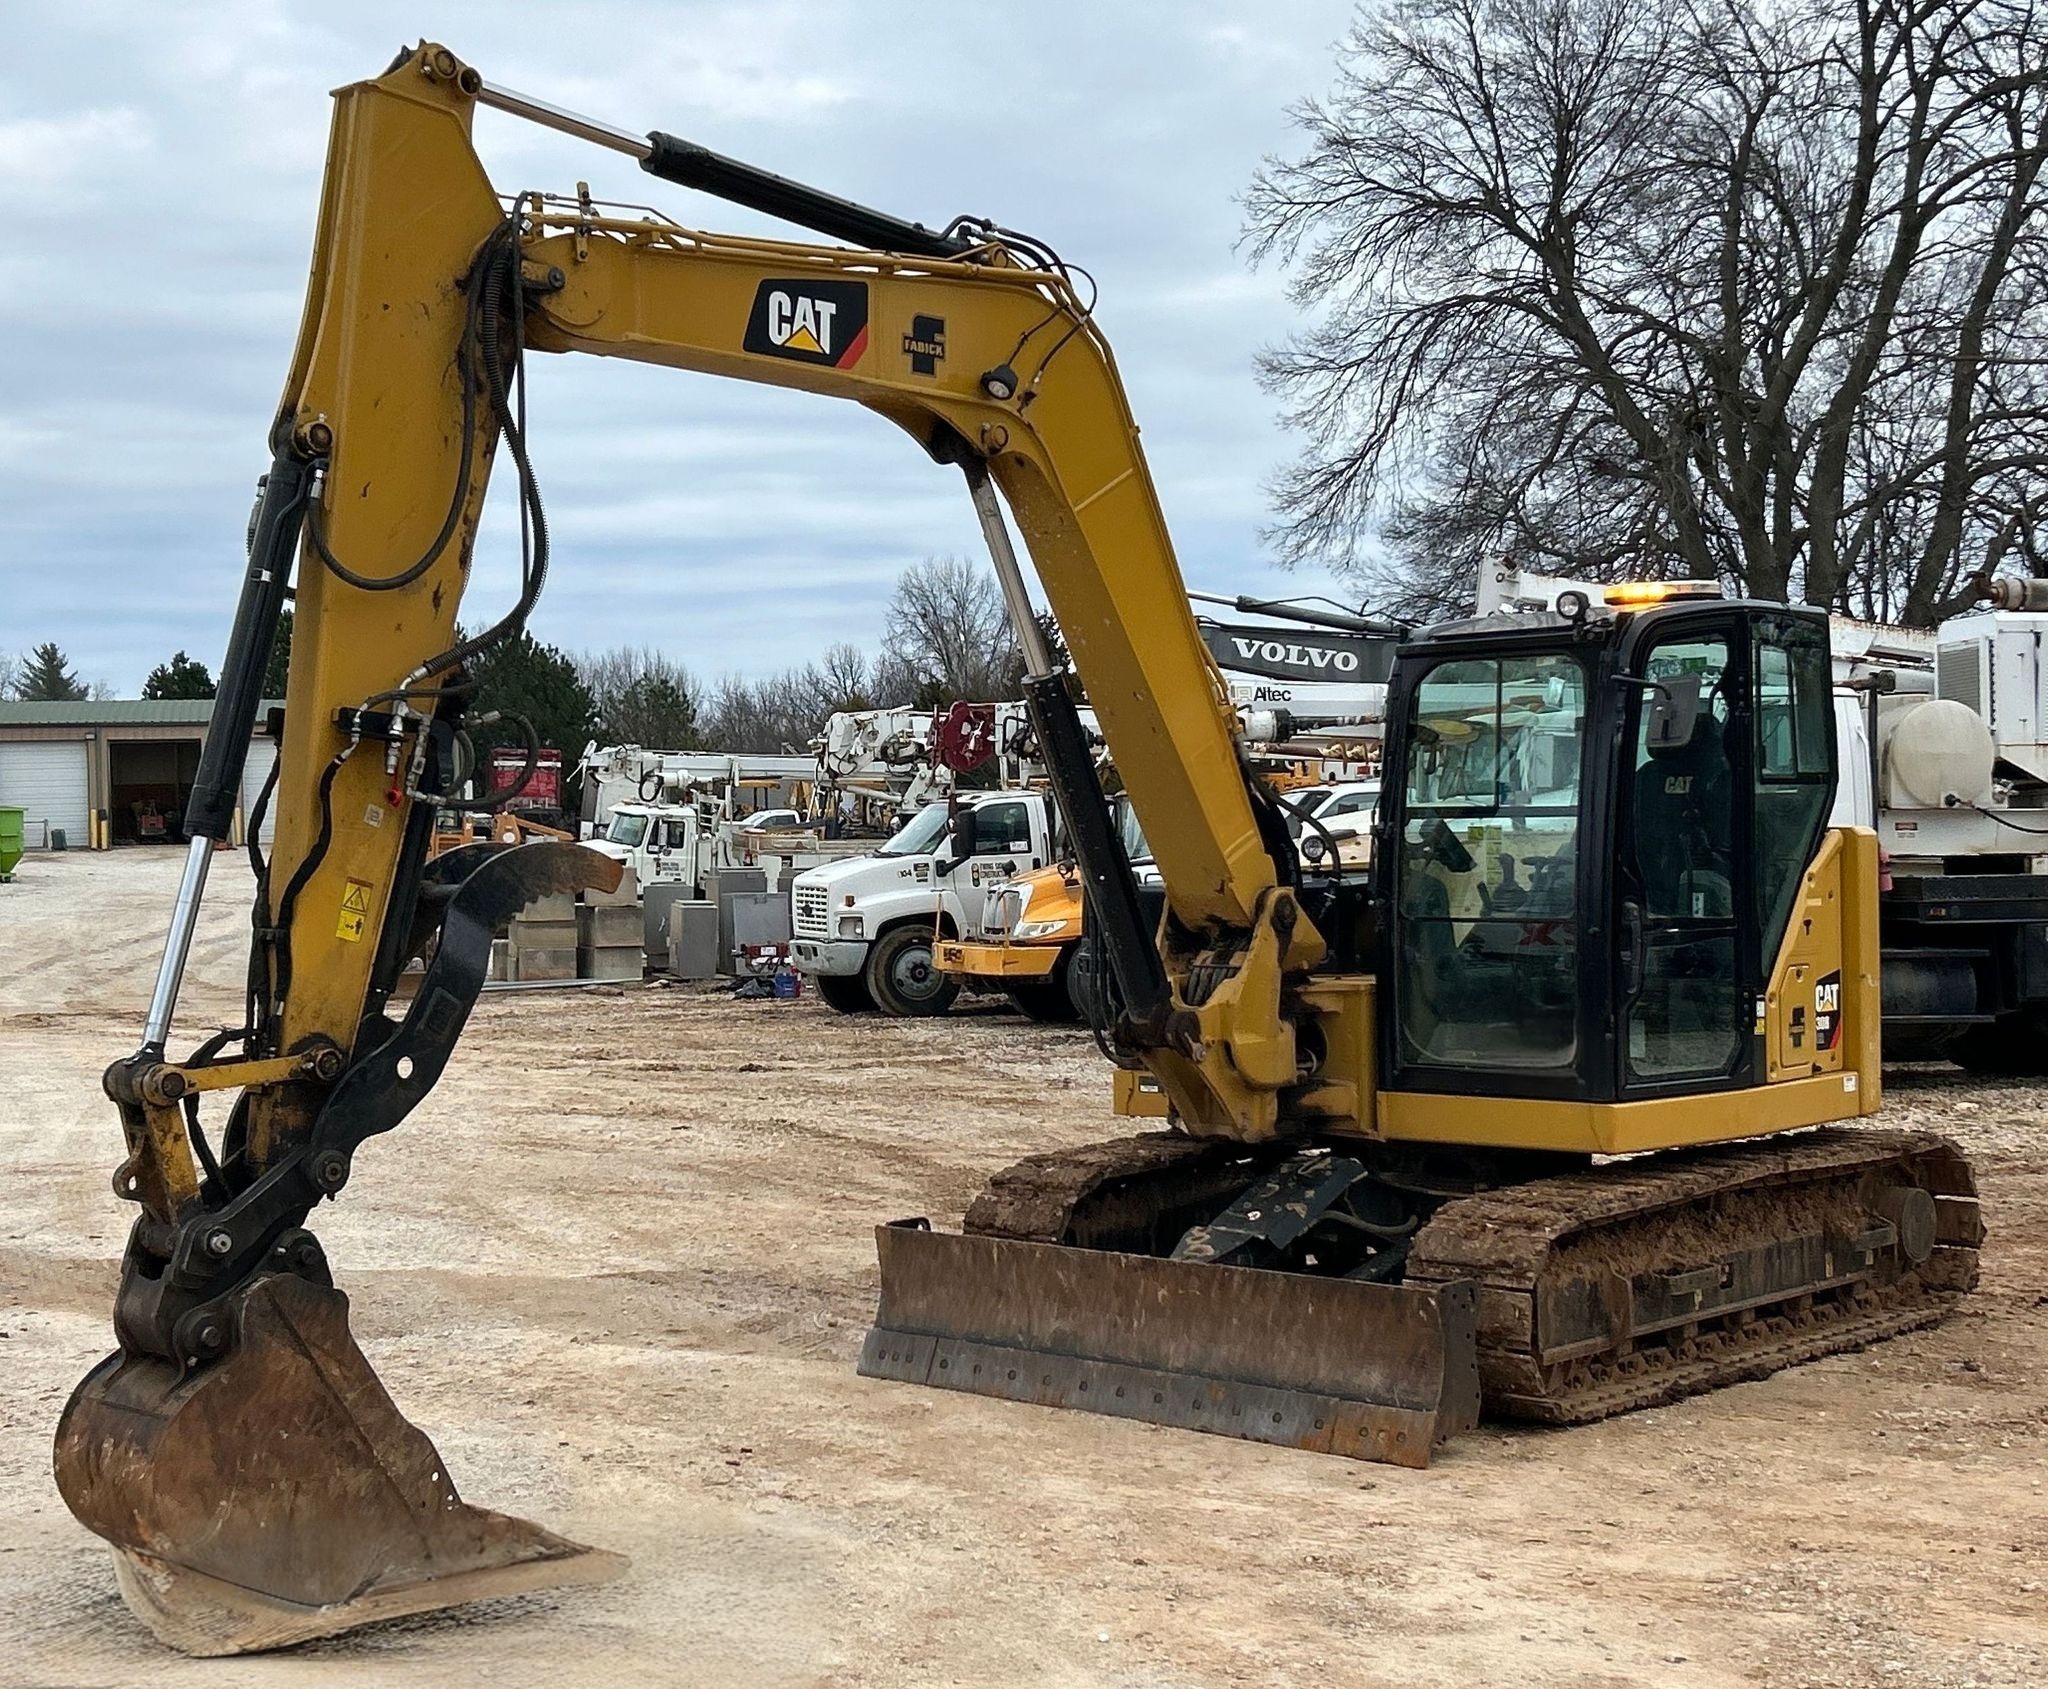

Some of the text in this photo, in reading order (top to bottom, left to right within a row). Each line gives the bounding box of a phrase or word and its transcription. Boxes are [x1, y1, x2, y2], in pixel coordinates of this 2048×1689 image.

[768, 290, 837, 355] CAT
[904, 339, 943, 357] FABICK
[1231, 638, 1358, 671] VOLVO
[1254, 686, 1292, 702] Altec
[1664, 776, 1693, 794] CAT
[1815, 983, 1840, 1012] CAT
